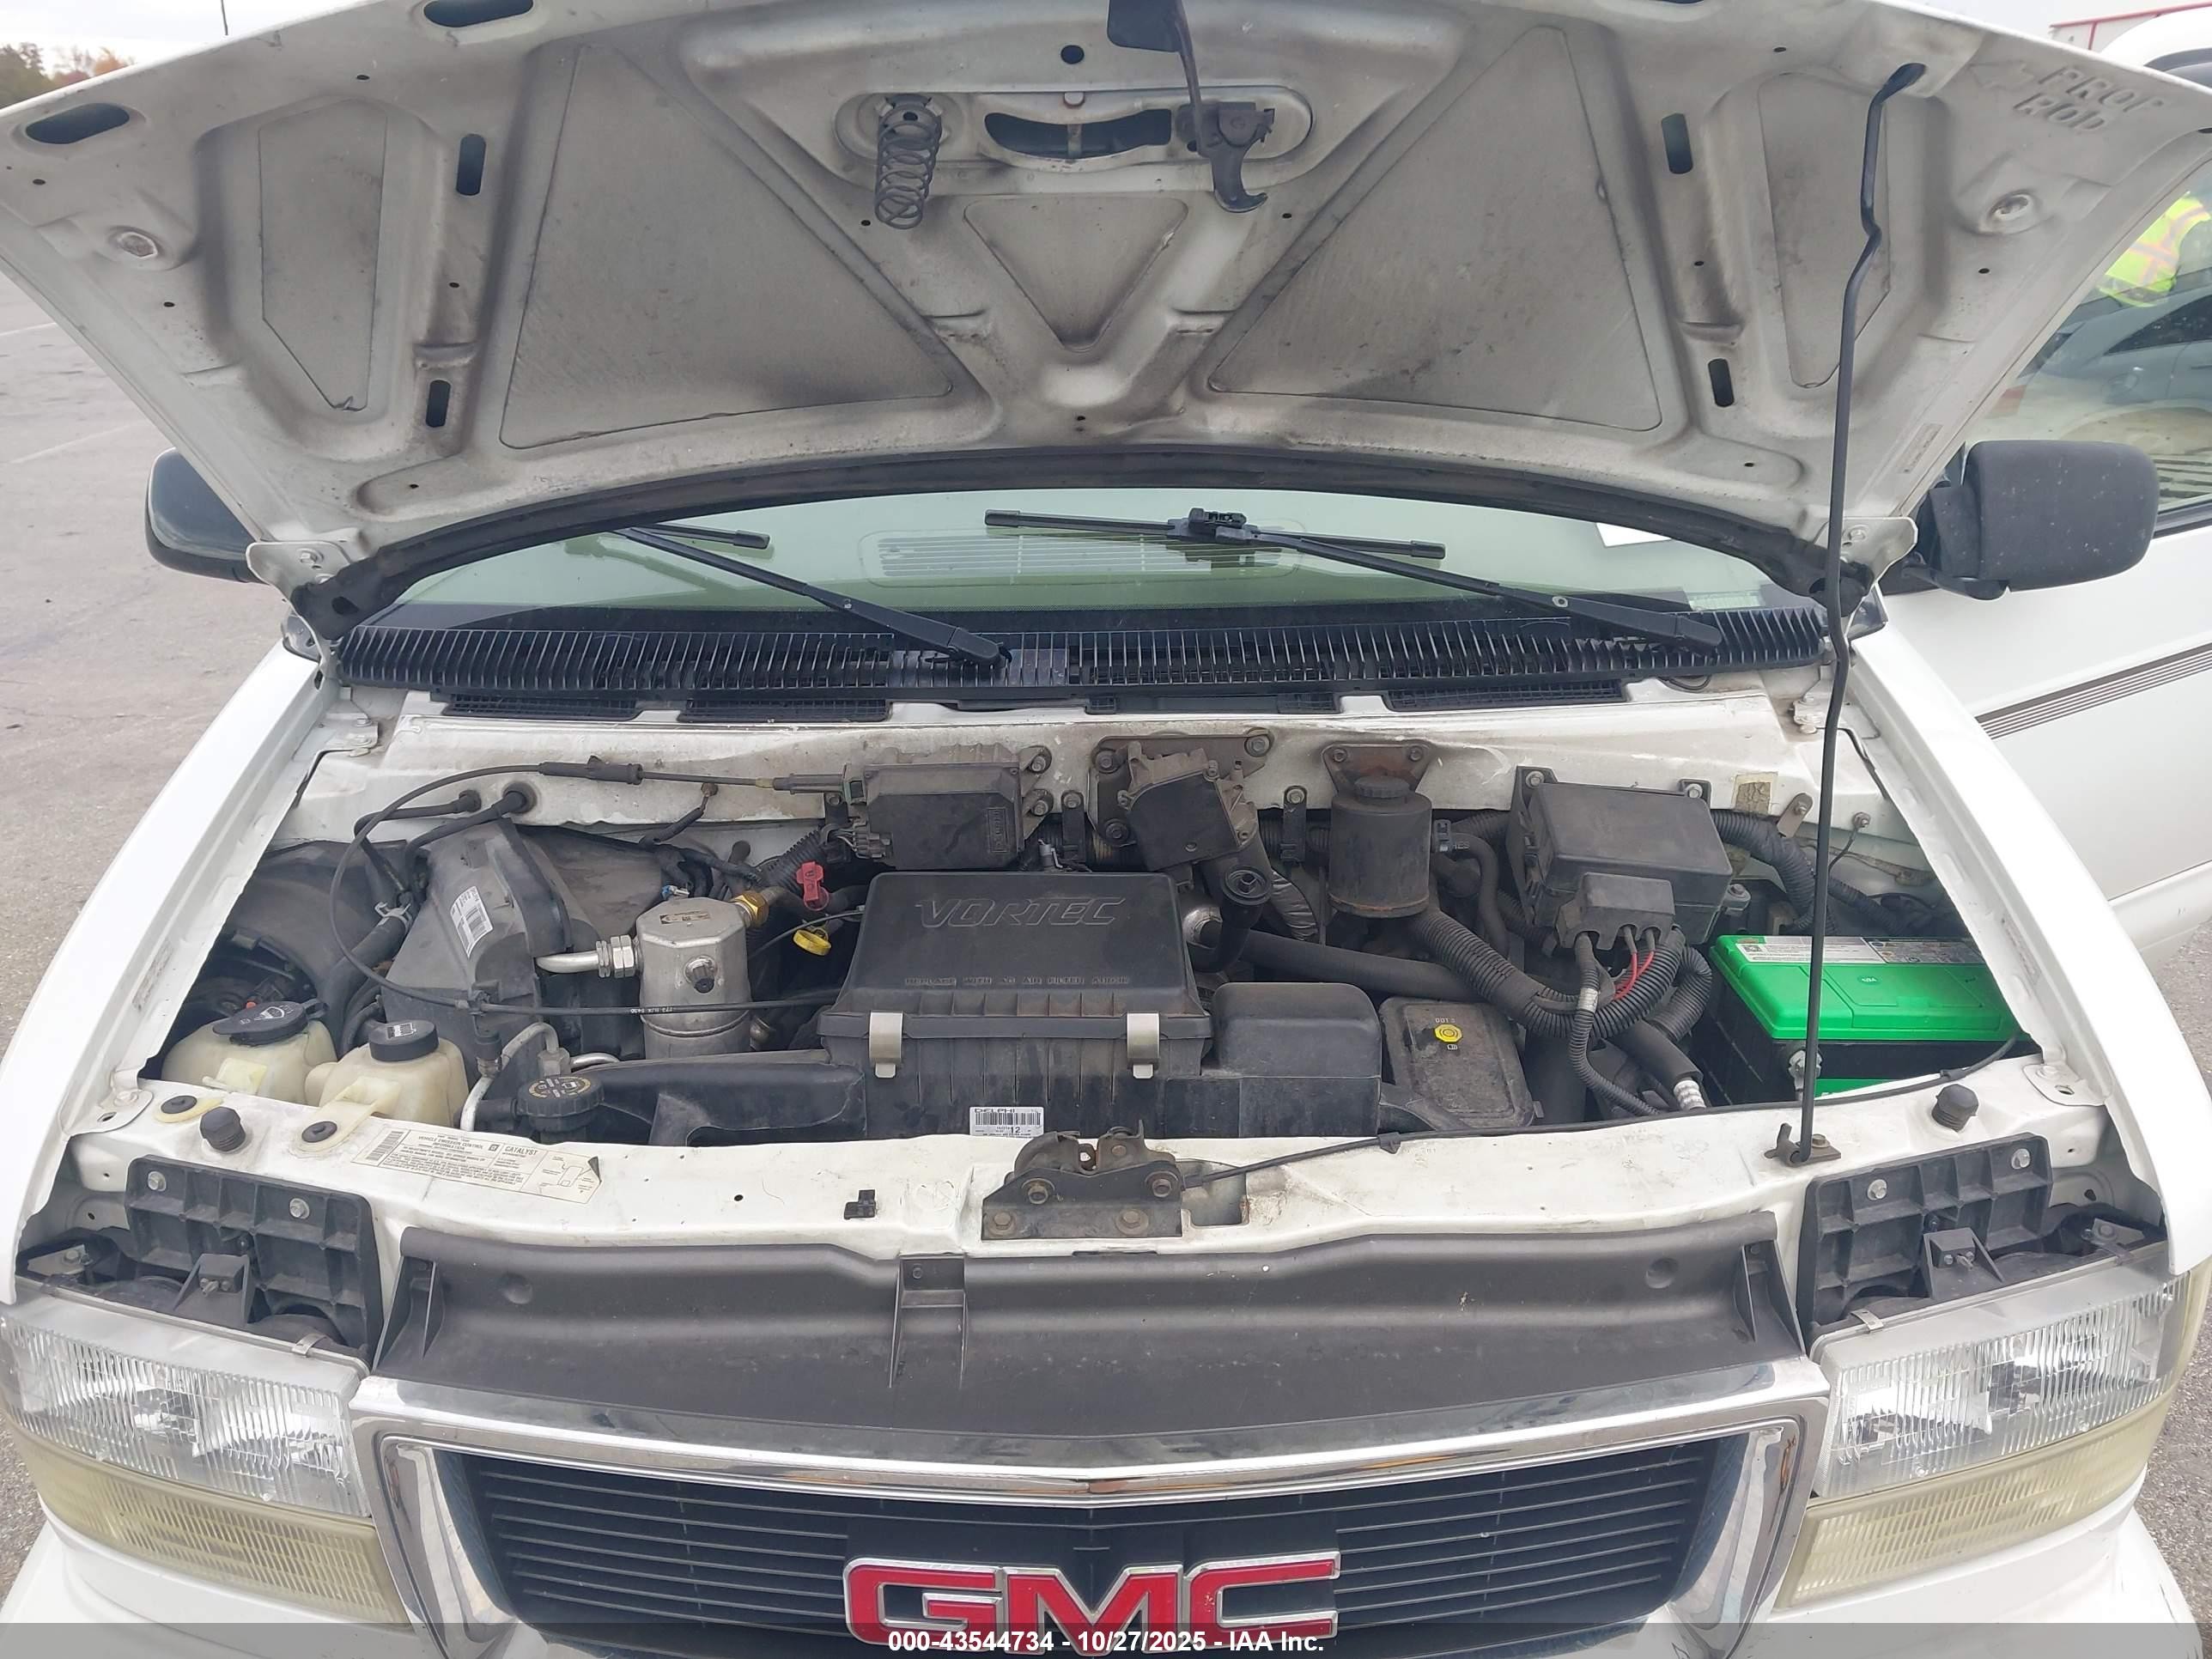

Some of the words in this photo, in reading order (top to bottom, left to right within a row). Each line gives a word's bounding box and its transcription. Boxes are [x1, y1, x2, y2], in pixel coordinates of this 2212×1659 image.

[2037, 65, 2166, 113] PROP
[2012, 92, 2108, 131] ROD
[915, 896, 1126, 928] VORTEC
[504, 1146, 538, 1156] CATALYST
[843, 1550, 1341, 1656] GMC
